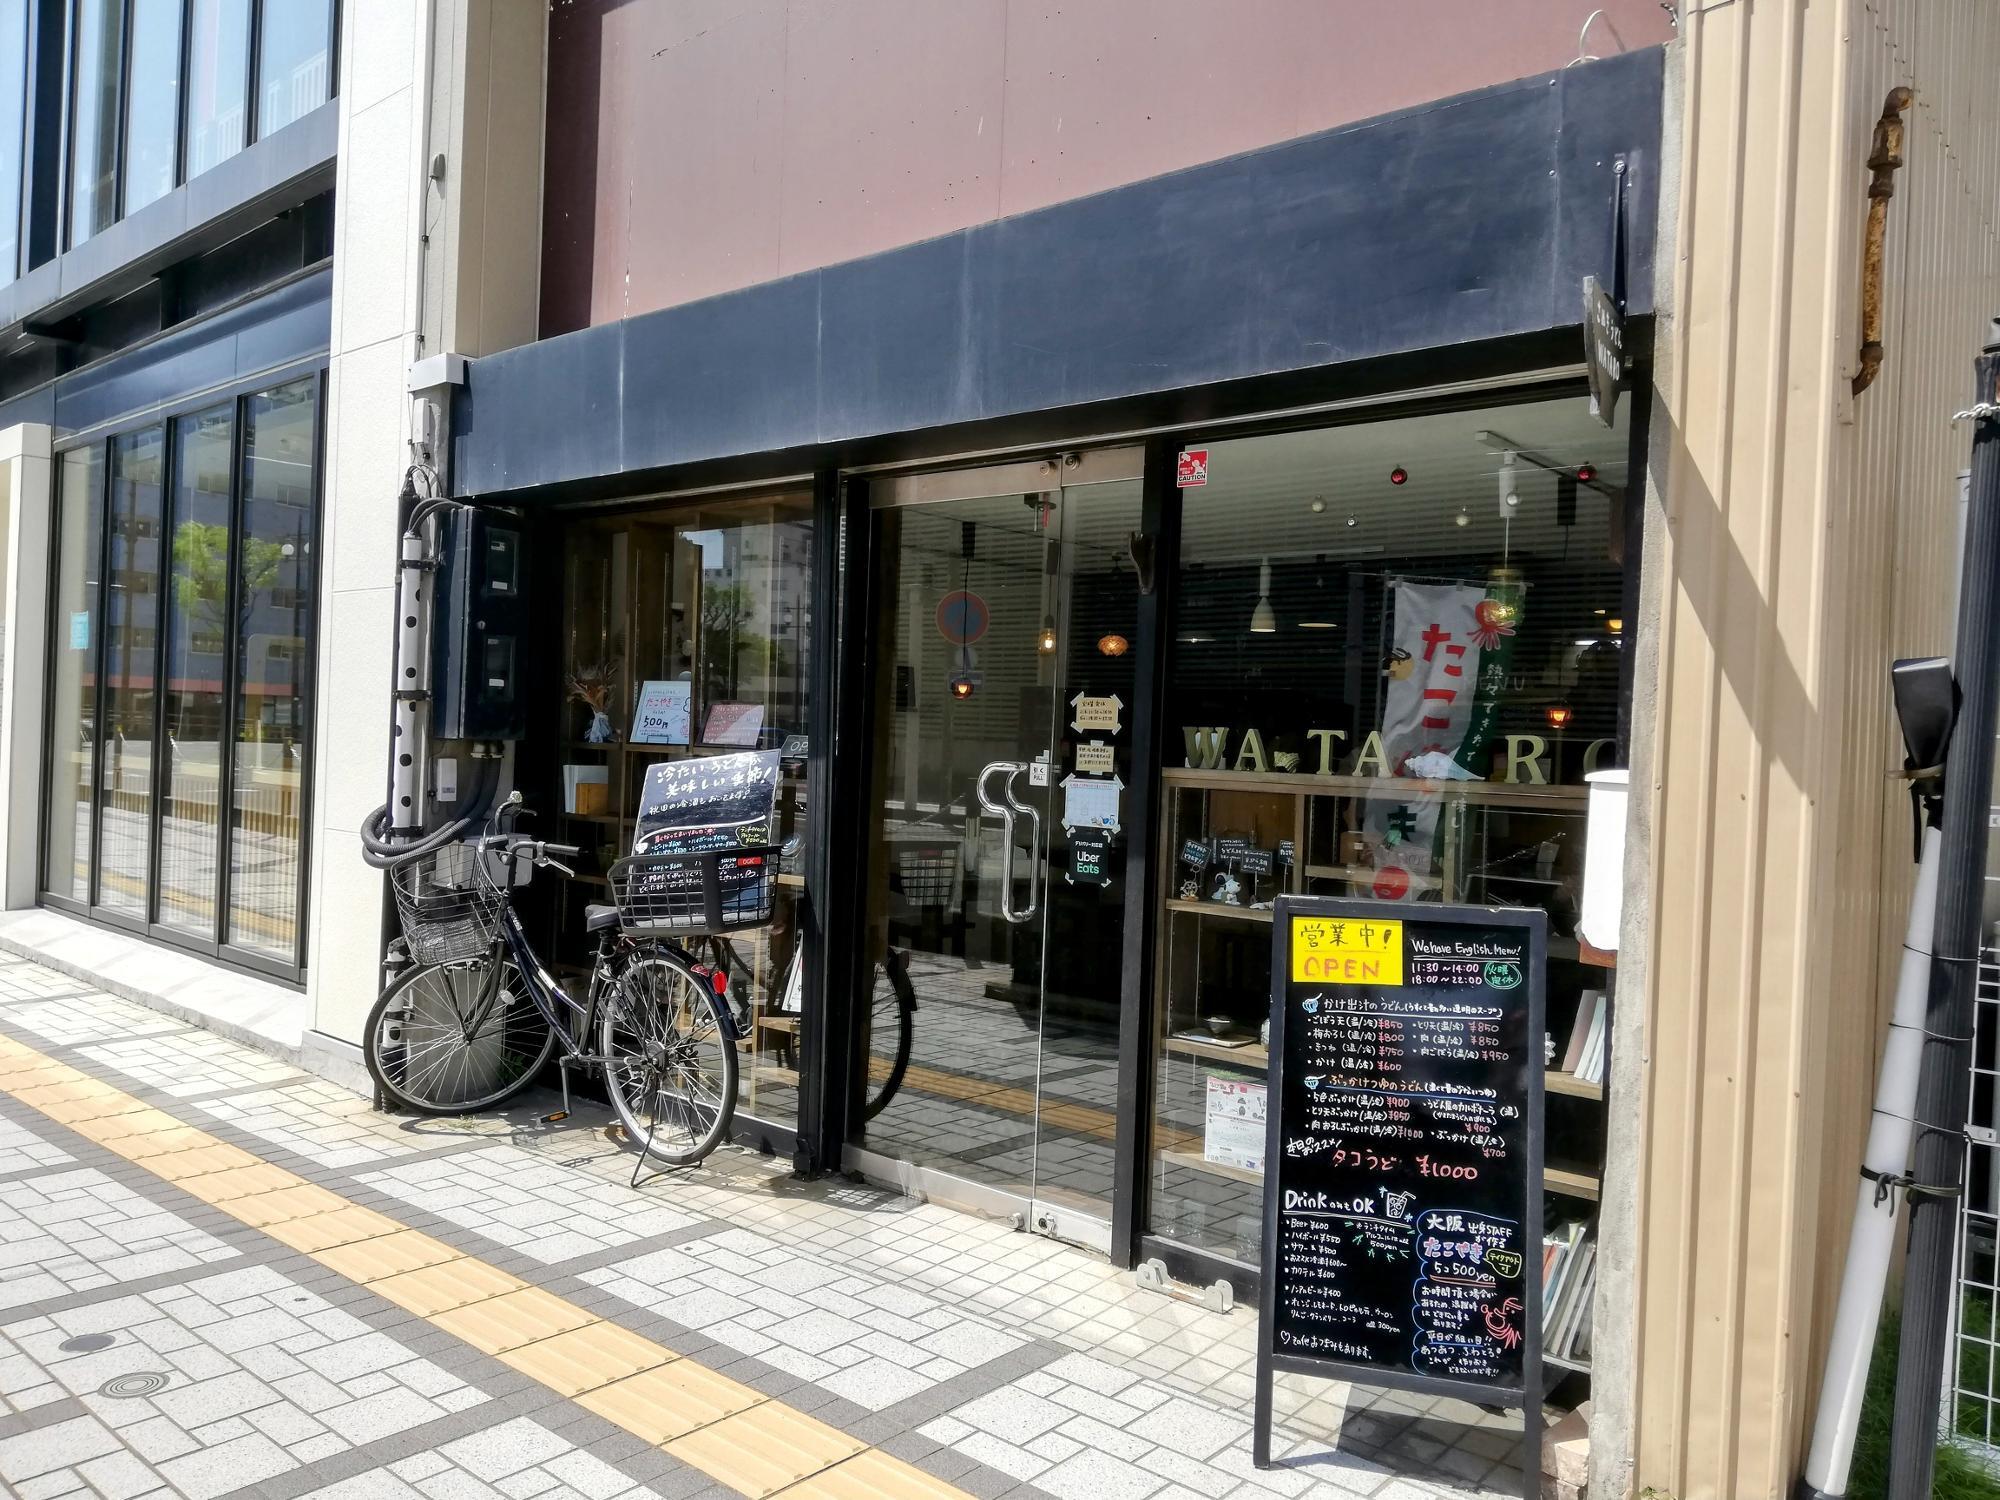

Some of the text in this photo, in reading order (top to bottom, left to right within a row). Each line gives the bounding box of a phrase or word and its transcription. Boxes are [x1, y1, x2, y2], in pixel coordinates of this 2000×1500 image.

[1077, 851, 1100, 863] Uber
[1077, 862, 1100, 874] Eats
[1411, 939, 1521, 956] We have English Menu!
[1304, 956, 1380, 979] OPEN
[1416, 1154, 1478, 1180] ¥1000
[1285, 1189, 1327, 1210] Drink
[1353, 1197, 1375, 1214] OK
[1426, 1213, 1465, 1233] 大阪
[1423, 1237, 1483, 1264] たこやき
[1452, 1262, 1495, 1283] 500yen
